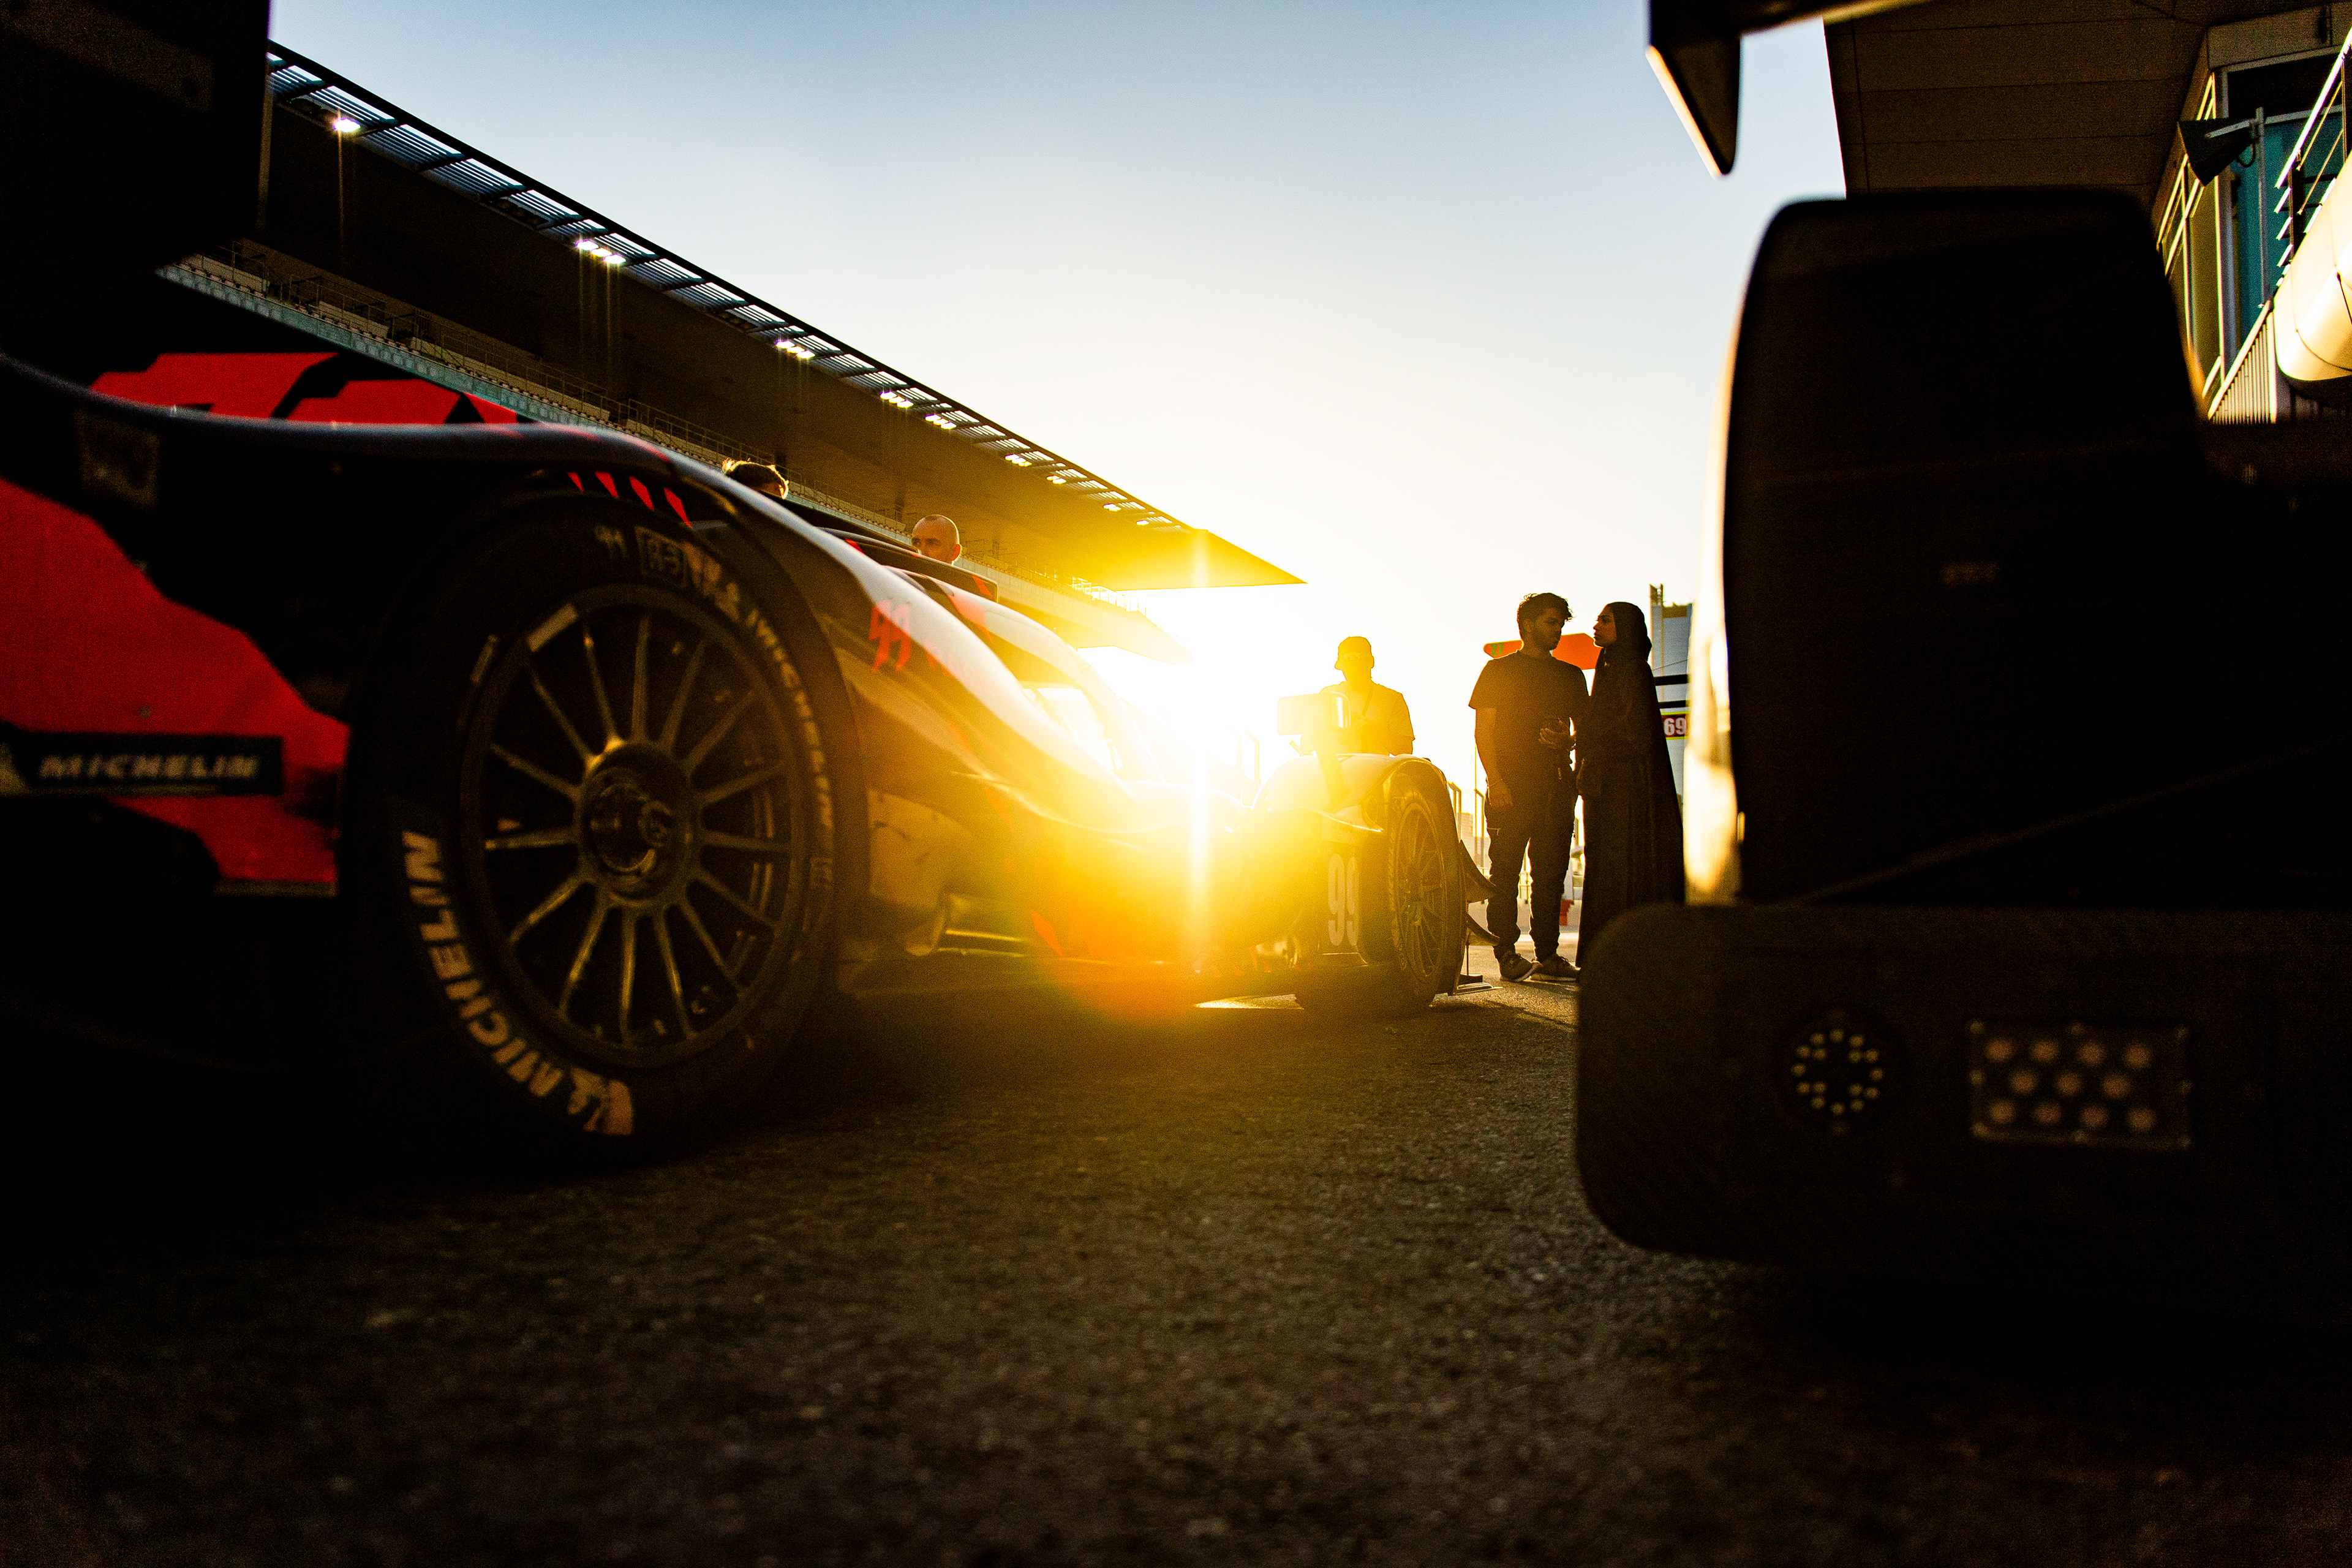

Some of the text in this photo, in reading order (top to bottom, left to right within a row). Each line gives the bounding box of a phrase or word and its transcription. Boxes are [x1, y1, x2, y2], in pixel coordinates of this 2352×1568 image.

[1490, 643, 1504, 656] 27
[37, 753, 262, 780] MICHELIN
[1327, 853, 1359, 946] 99
[402, 830, 564, 1098] MICHELIN
